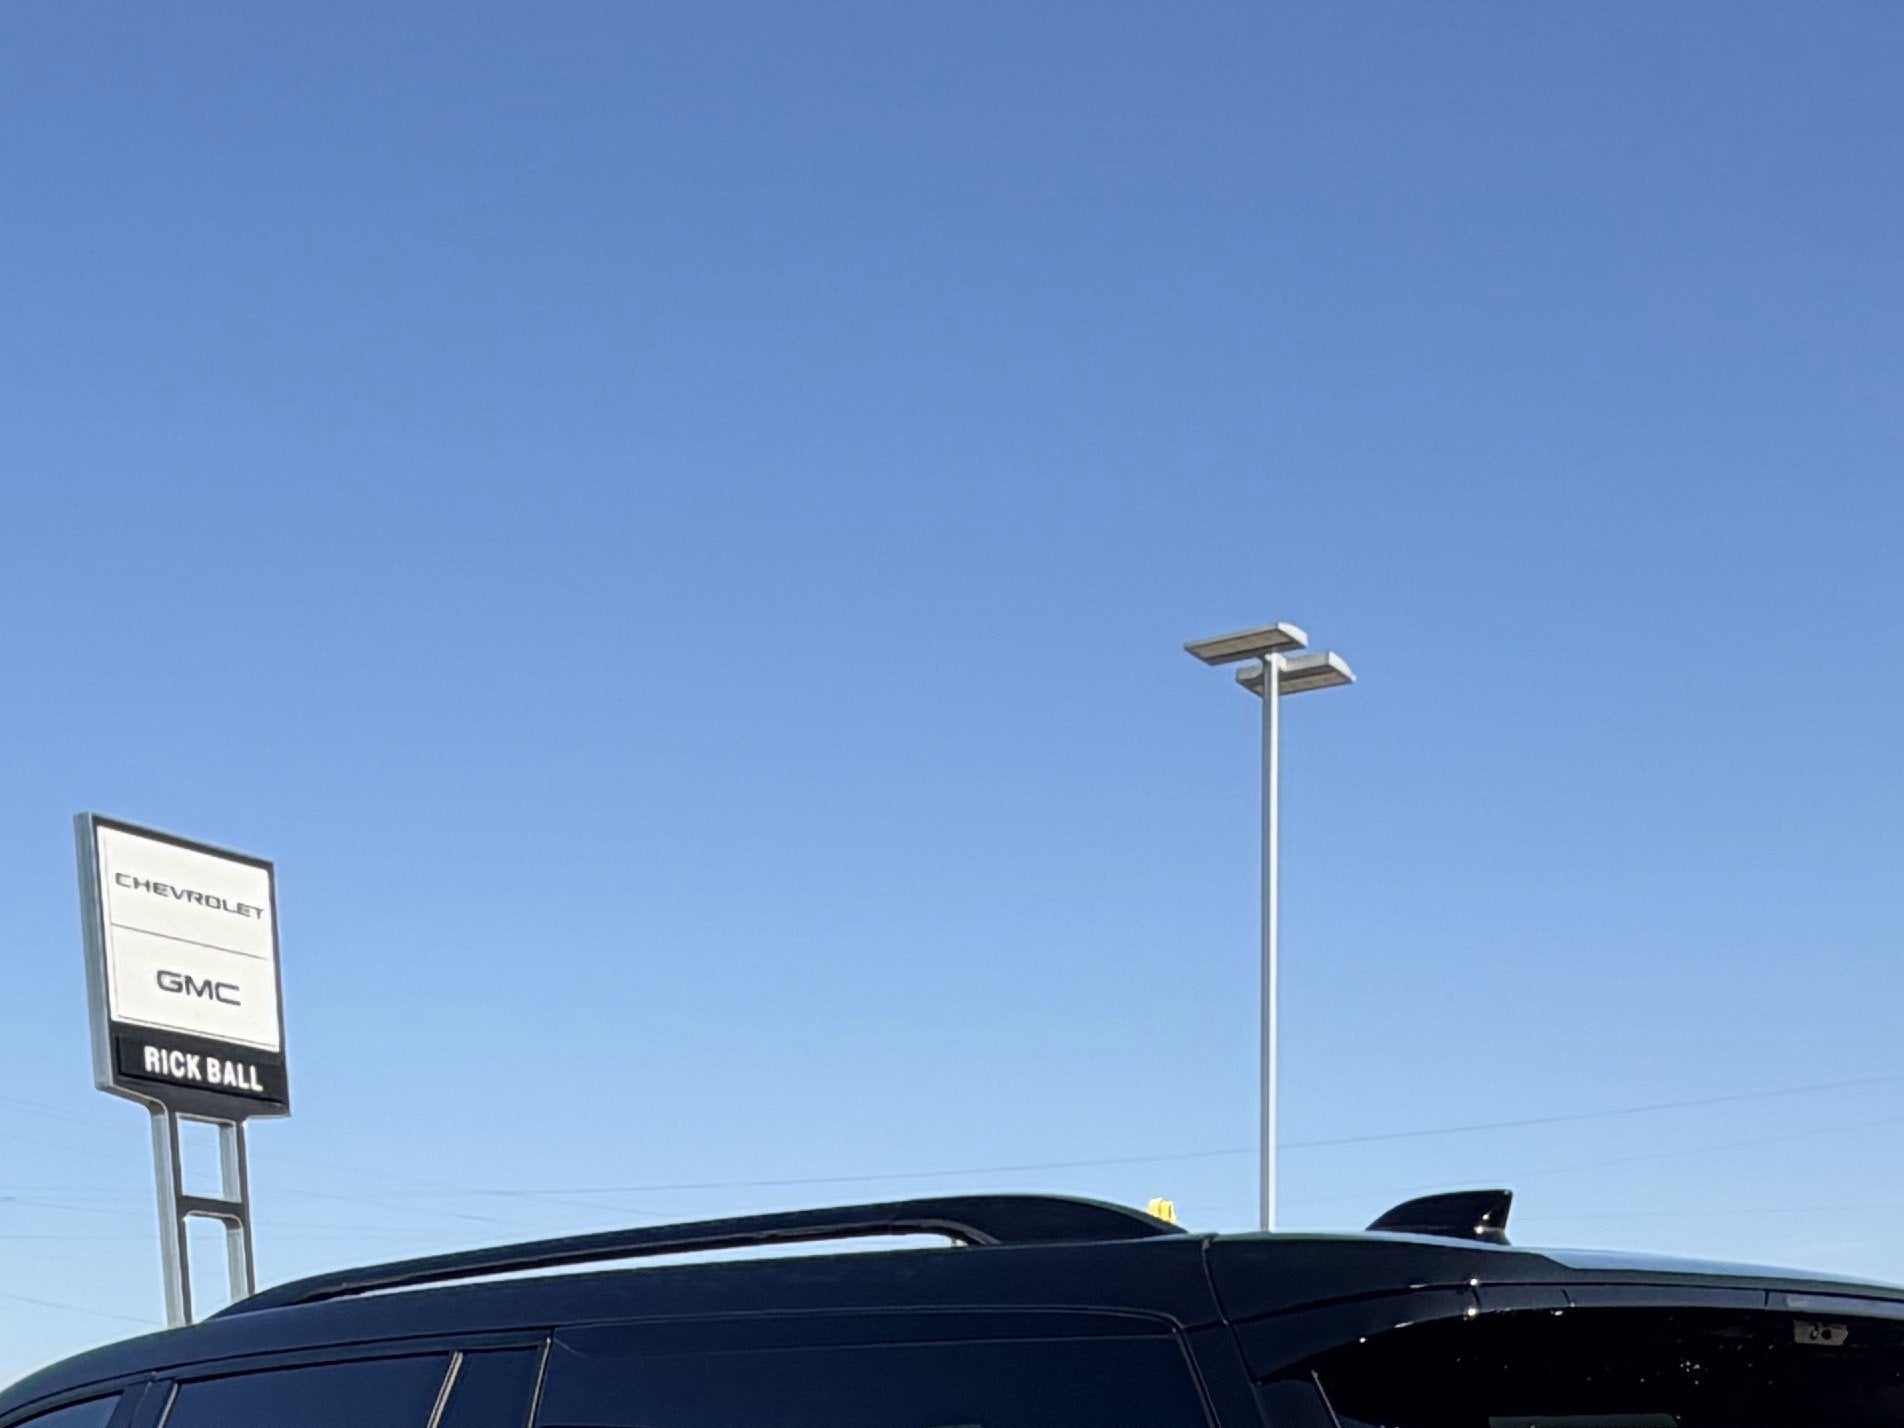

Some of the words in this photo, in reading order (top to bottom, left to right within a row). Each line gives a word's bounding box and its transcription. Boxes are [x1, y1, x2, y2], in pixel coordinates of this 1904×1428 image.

[115, 872, 265, 920] CHEVROLET
[156, 969, 241, 1006] GMC
[144, 1045, 202, 1083] RICK
[206, 1057, 264, 1092] BALL
